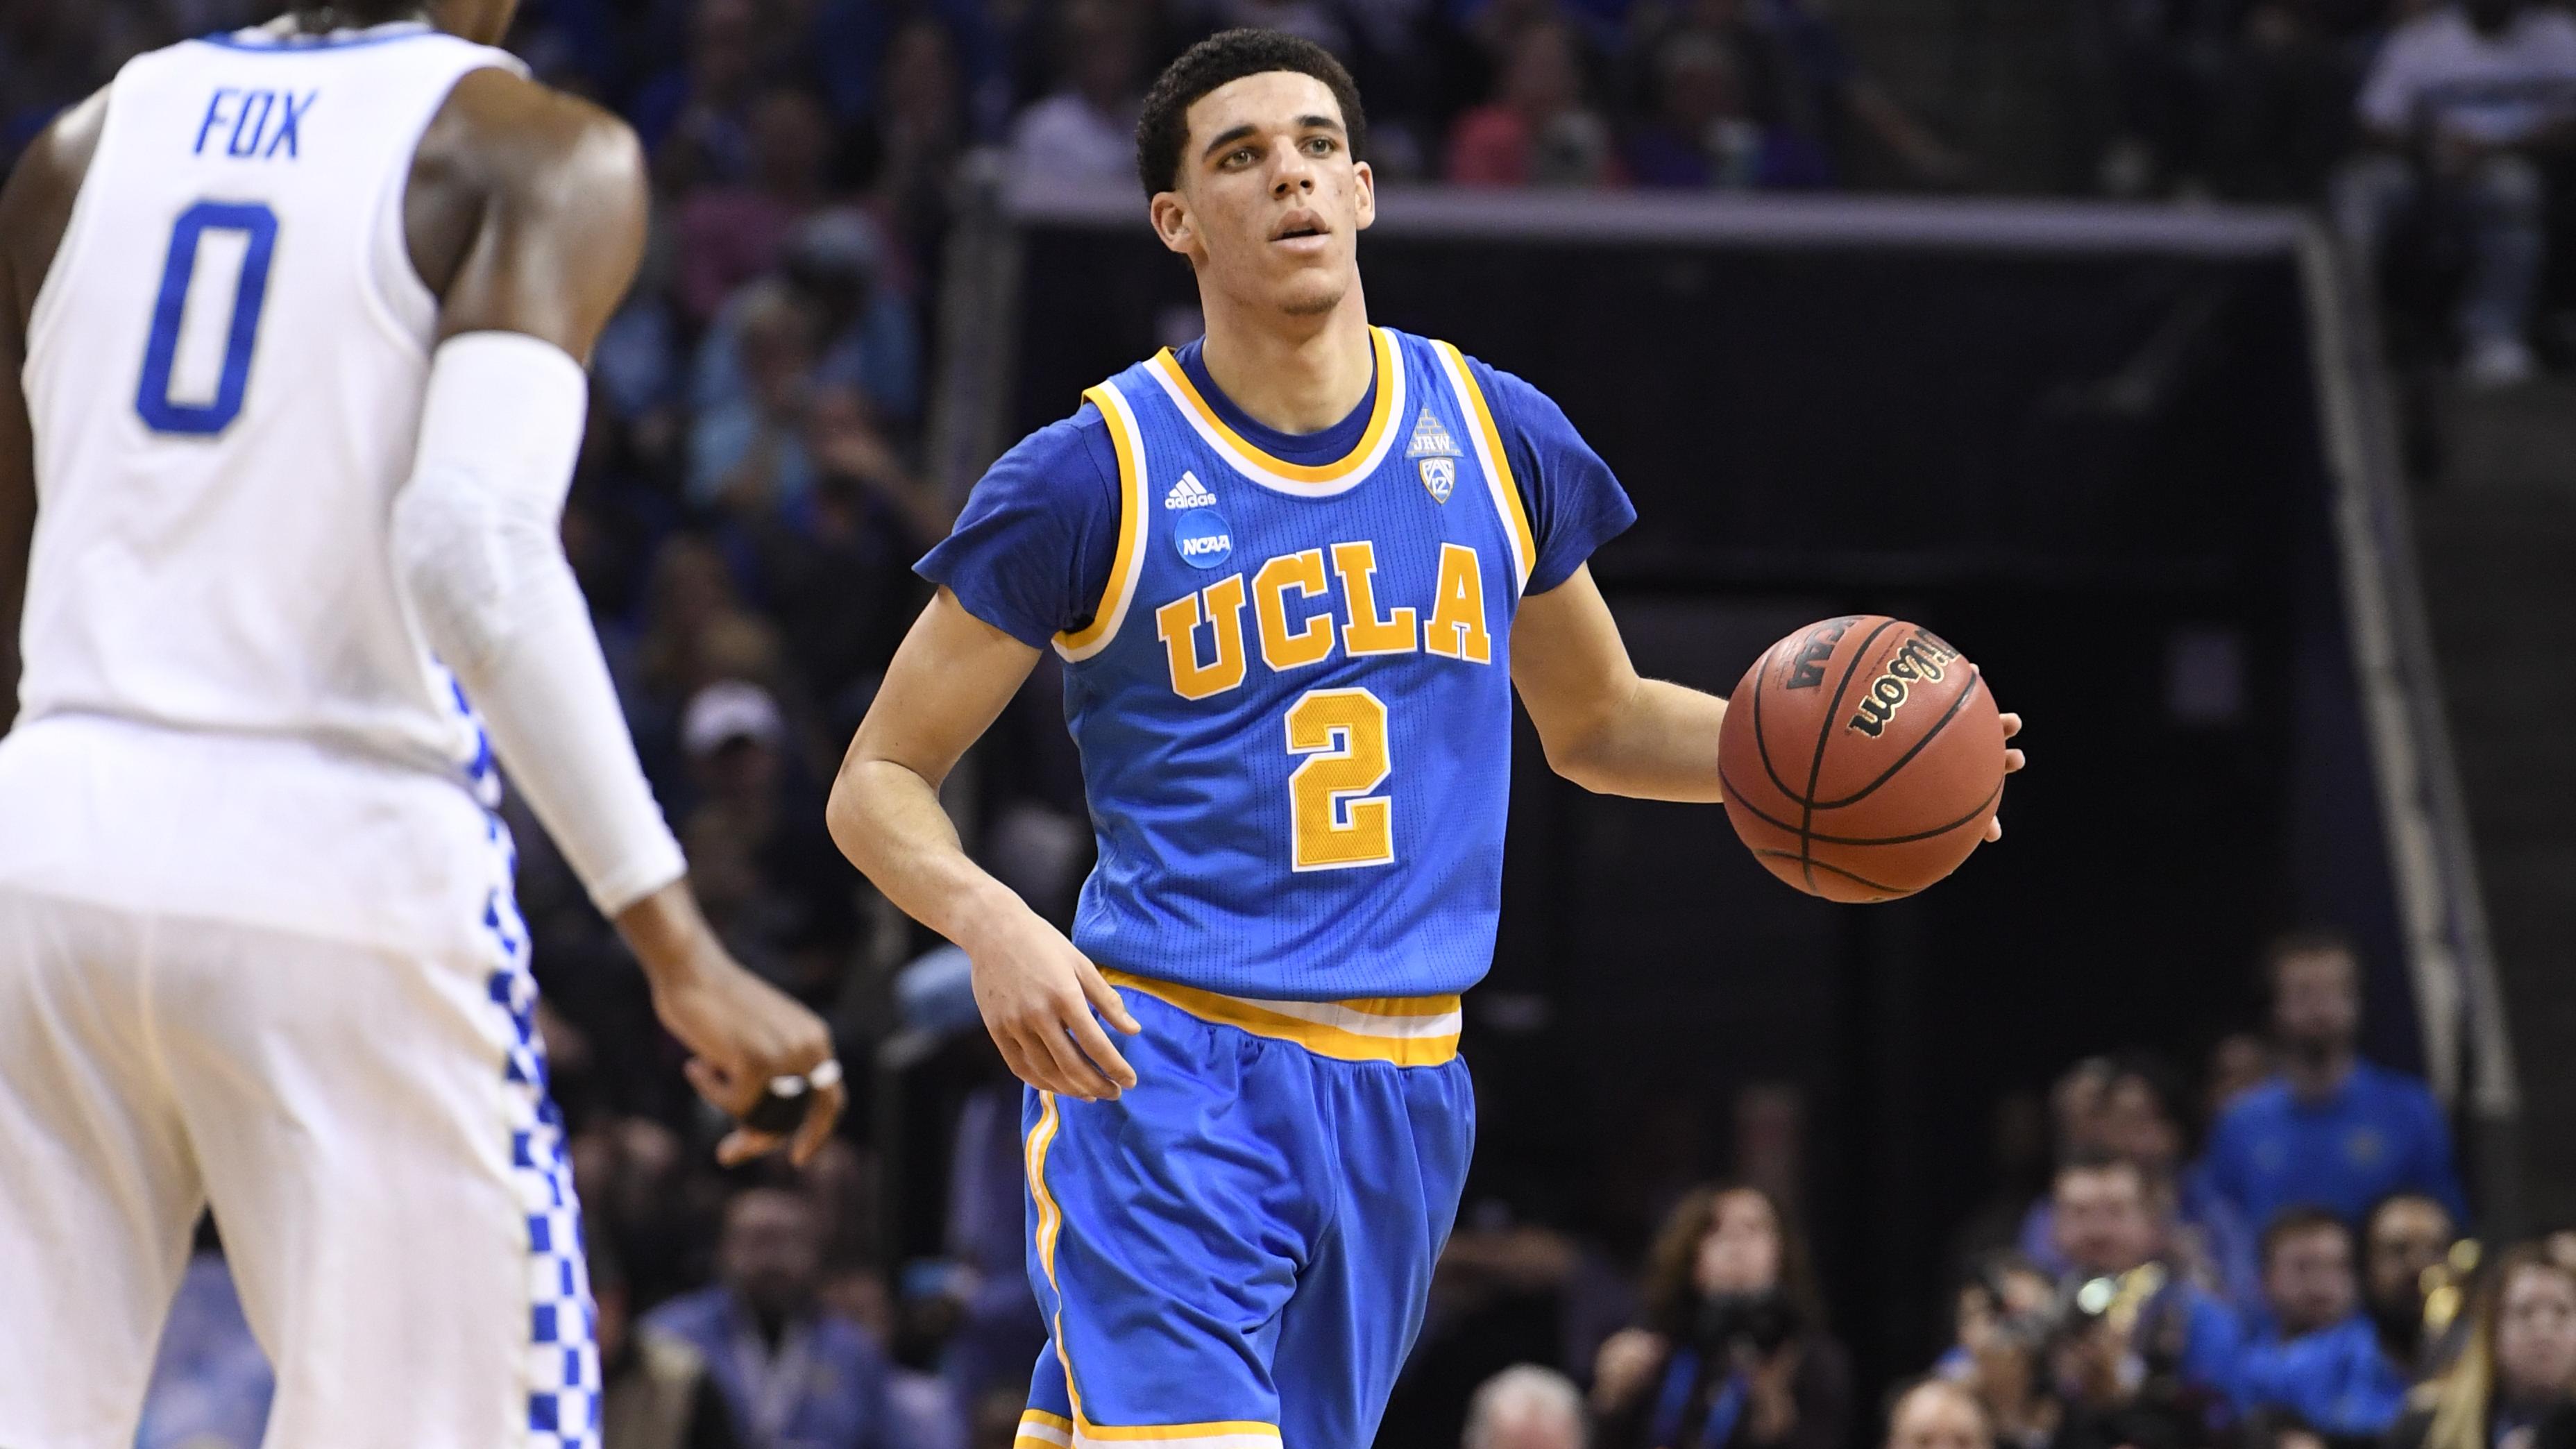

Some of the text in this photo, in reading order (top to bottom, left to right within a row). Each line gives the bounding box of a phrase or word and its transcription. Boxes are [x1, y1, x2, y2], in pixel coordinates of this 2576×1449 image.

[194, 88, 318, 159] FOX
[135, 201, 278, 435] 0
[1413, 435, 1450, 451] JRW
[1164, 493, 1217, 510] adidas
[1432, 476, 1448, 494] 12
[1183, 534, 1232, 556] NCAA
[1155, 540, 1491, 701] UCLA
[1284, 686, 1395, 873] 2
